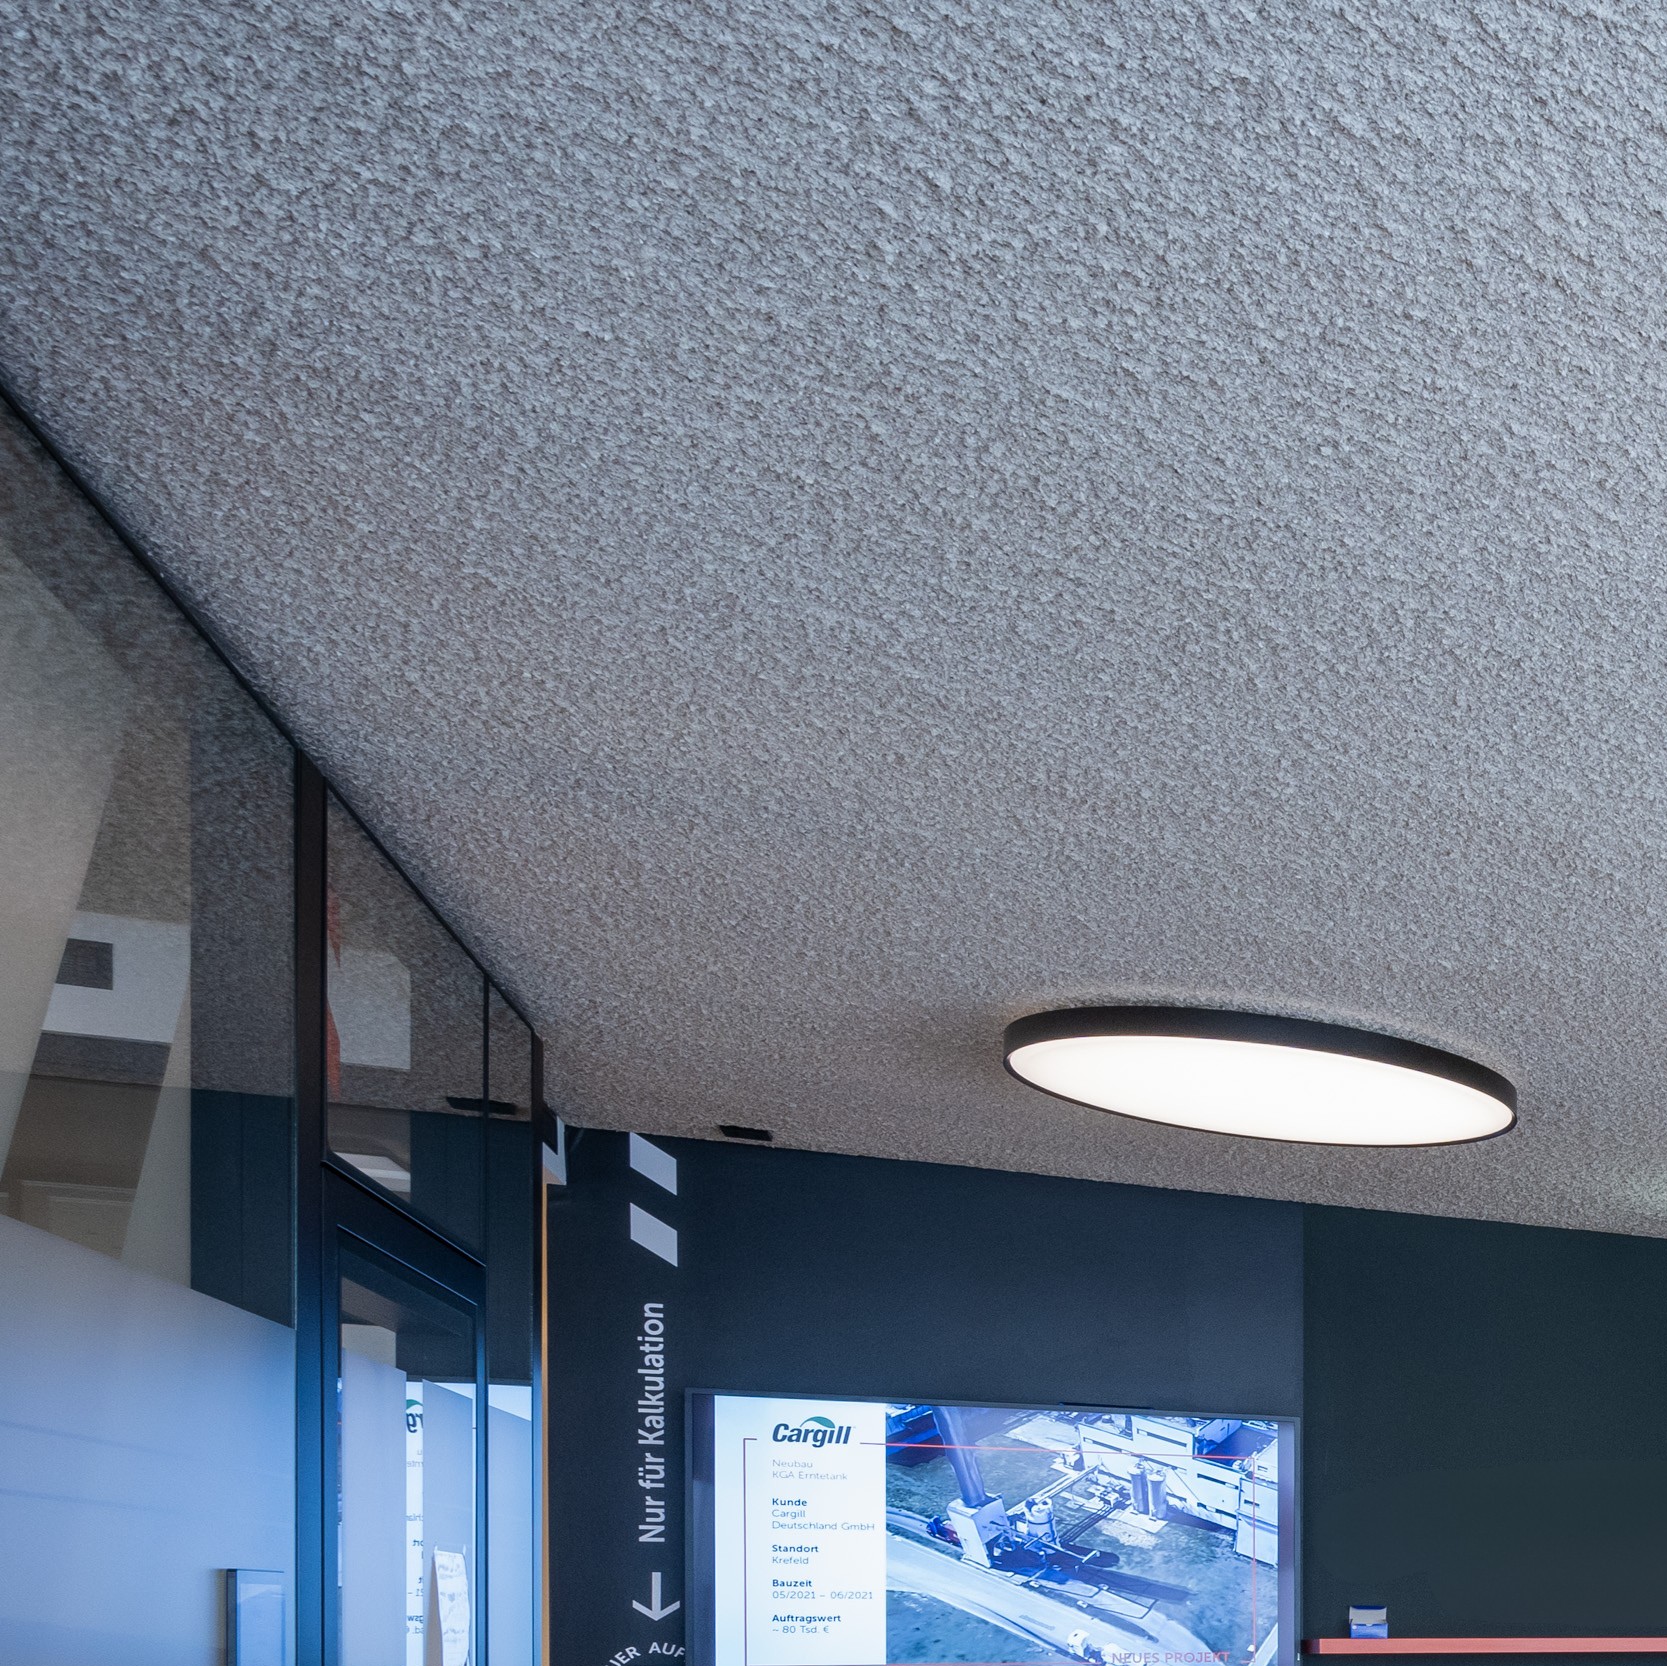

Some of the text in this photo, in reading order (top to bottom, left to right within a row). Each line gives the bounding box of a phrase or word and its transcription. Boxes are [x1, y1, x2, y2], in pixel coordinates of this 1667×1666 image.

[637, 1302, 666, 1543] Nur für Kalkulation
[772, 1422, 852, 1448] Cargill
[772, 1459, 814, 1468] Neubau
[772, 1498, 808, 1507] Kunde
[772, 1509, 806, 1519] Cargill
[772, 1521, 875, 1531] Deutschland GmbH
[772, 1544, 819, 1553] Standort
[772, 1556, 809, 1565] Krefeld
[772, 1579, 812, 1588] Bauzeit
[772, 1590, 816, 1600] 05/2021
[830, 1590, 873, 1600] 06/2021
[772, 1614, 842, 1624] Auftragswert
[782, 1625, 796, 1634] 80
[1111, 1651, 1230, 1664] NEUES PROJEKT
